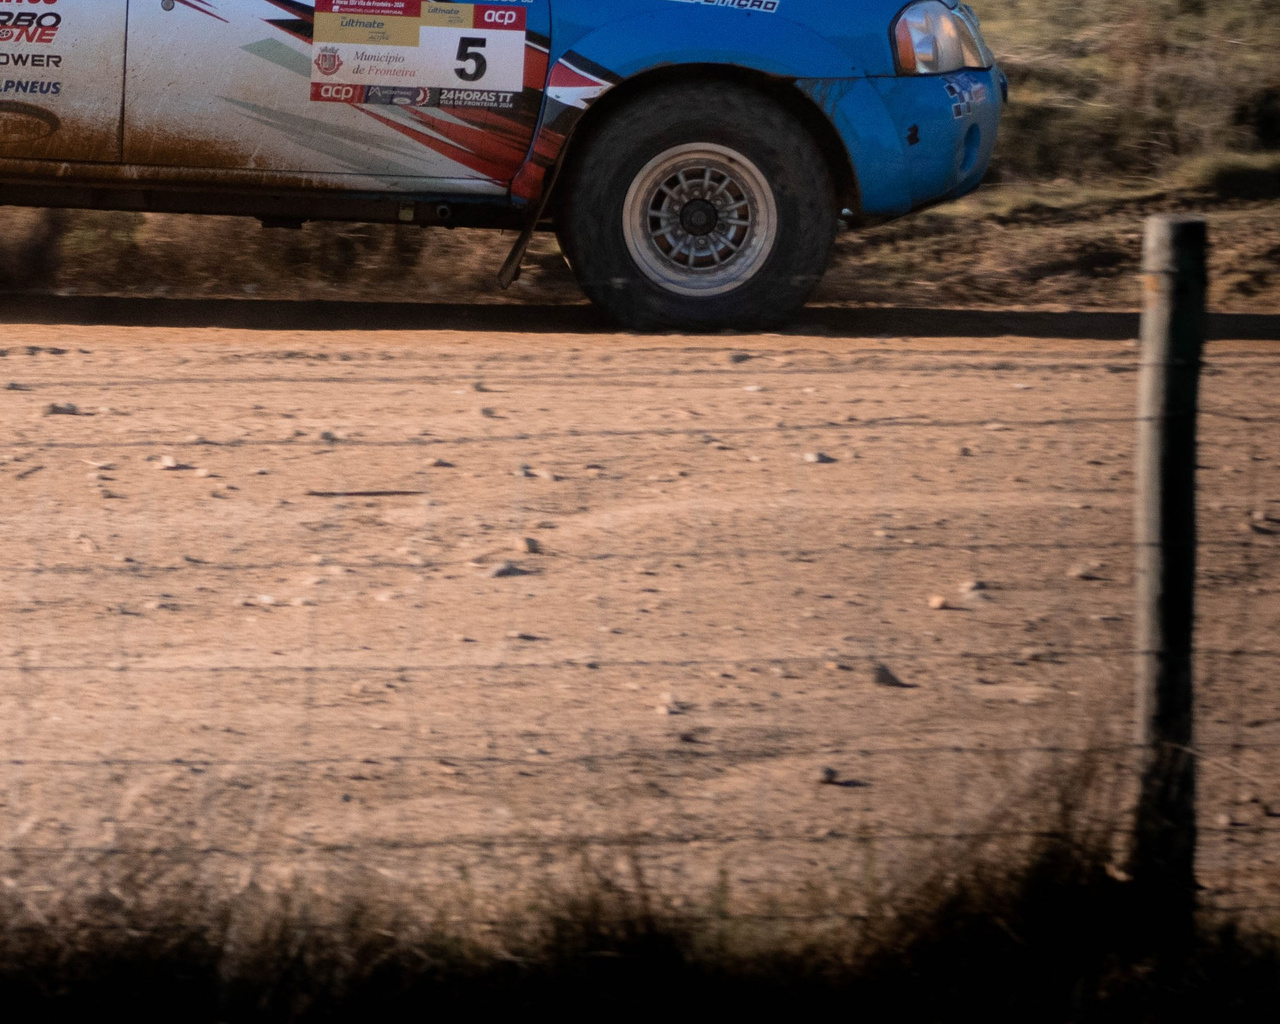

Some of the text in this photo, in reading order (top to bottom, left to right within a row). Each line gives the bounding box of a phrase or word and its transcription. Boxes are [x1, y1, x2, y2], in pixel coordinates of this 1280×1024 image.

[484, 9, 517, 25] acp
[454, 37, 487, 82] 5
[352, 65, 417, 77] de Fronteira
[321, 85, 353, 101] acp
[440, 89, 513, 103] 24HORAS TT
